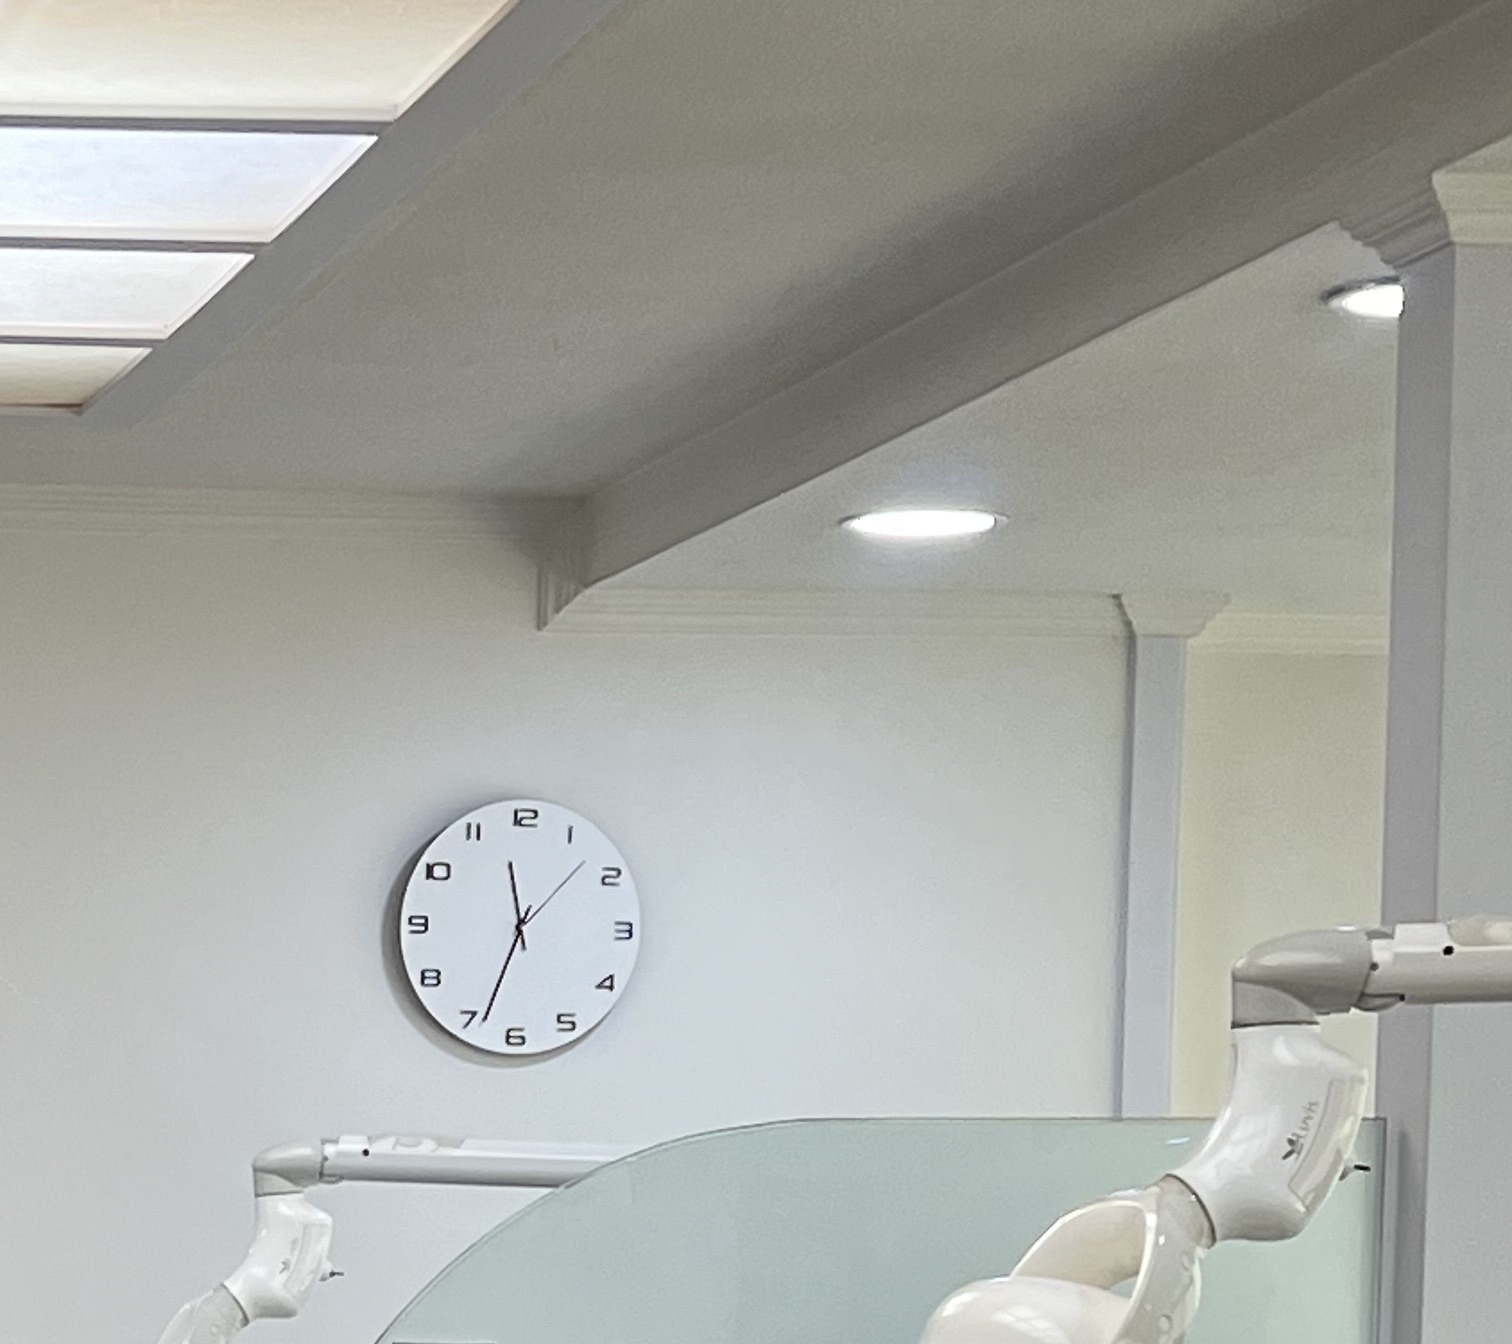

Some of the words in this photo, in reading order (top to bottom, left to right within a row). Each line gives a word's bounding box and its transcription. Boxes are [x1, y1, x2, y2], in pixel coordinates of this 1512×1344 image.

[512, 808, 539, 828] 12
[465, 822, 482, 841] 11
[567, 825, 574, 845] 1
[425, 862, 451, 881] 10
[600, 867, 622, 887] 2
[407, 915, 429, 934] 9
[613, 920, 634, 941] 3
[420, 968, 442, 988] 8
[594, 973, 616, 992] 4
[459, 1010, 478, 1029] 7
[555, 1012, 577, 1032] 5
[504, 1027, 527, 1046] 6
